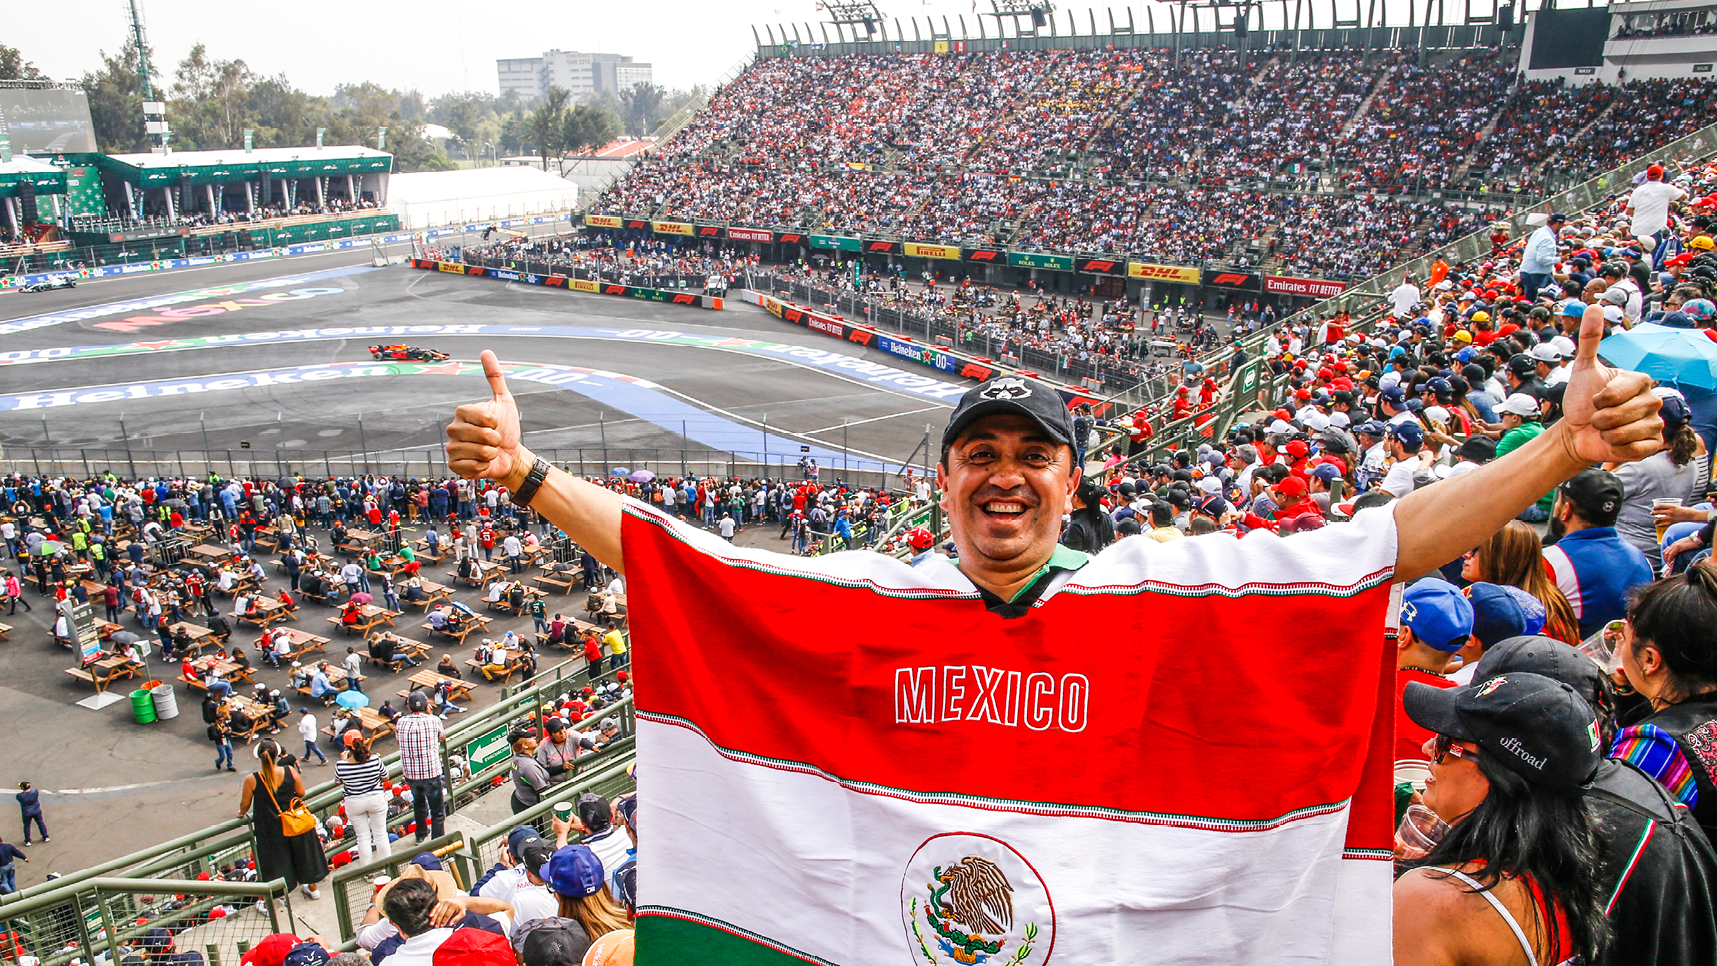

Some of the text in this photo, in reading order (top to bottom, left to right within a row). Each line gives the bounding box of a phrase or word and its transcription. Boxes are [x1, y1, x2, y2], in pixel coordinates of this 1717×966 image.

[917, 246, 946, 257] PIRELLI
[1140, 266, 1182, 279] DHL
[1268, 280, 1343, 296] Emirates FLY BETTER
[890, 341, 922, 361] Heineken
[12, 364, 393, 410] Heineken
[894, 665, 1090, 733] MEXICO
[1500, 736, 1548, 770] offroad
